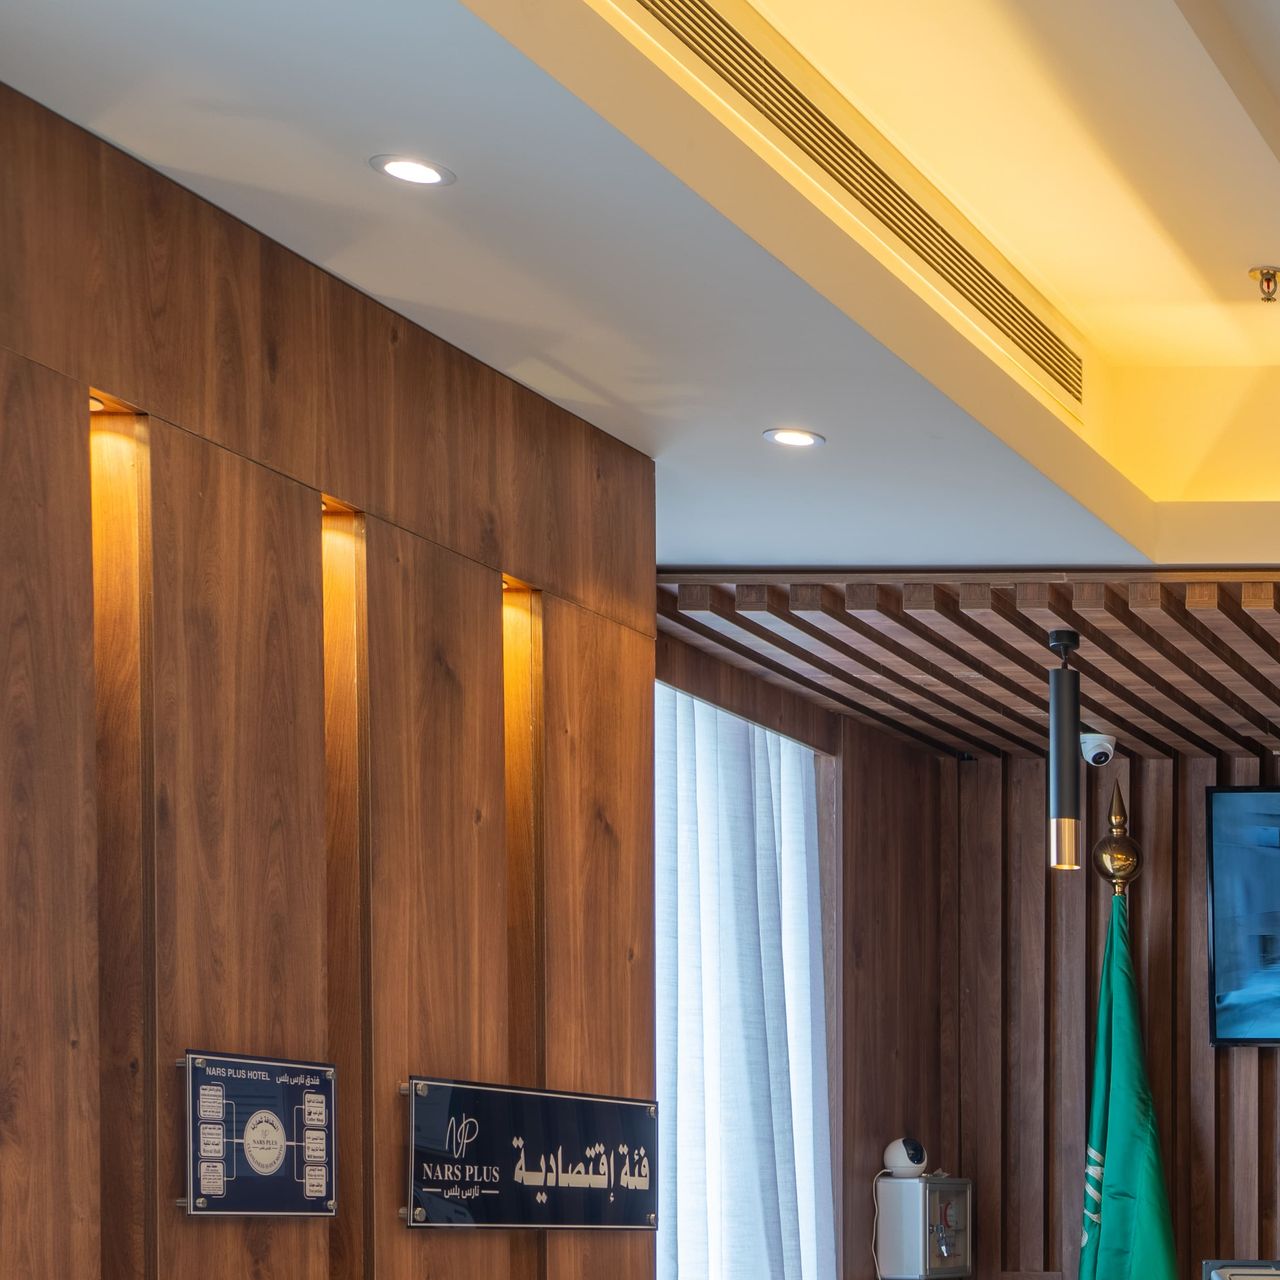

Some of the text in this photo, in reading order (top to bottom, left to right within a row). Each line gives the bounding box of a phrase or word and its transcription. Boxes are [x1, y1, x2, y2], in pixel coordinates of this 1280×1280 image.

[206, 1066, 271, 1081] NARS PLUS HOTEL
[275, 1073, 320, 1087] فندق نارس بلس
[422, 1162, 500, 1183] NARS PLUS
[511, 1136, 650, 1204] فئة إقتصادية
[443, 1184, 480, 1200] نارس بلس
